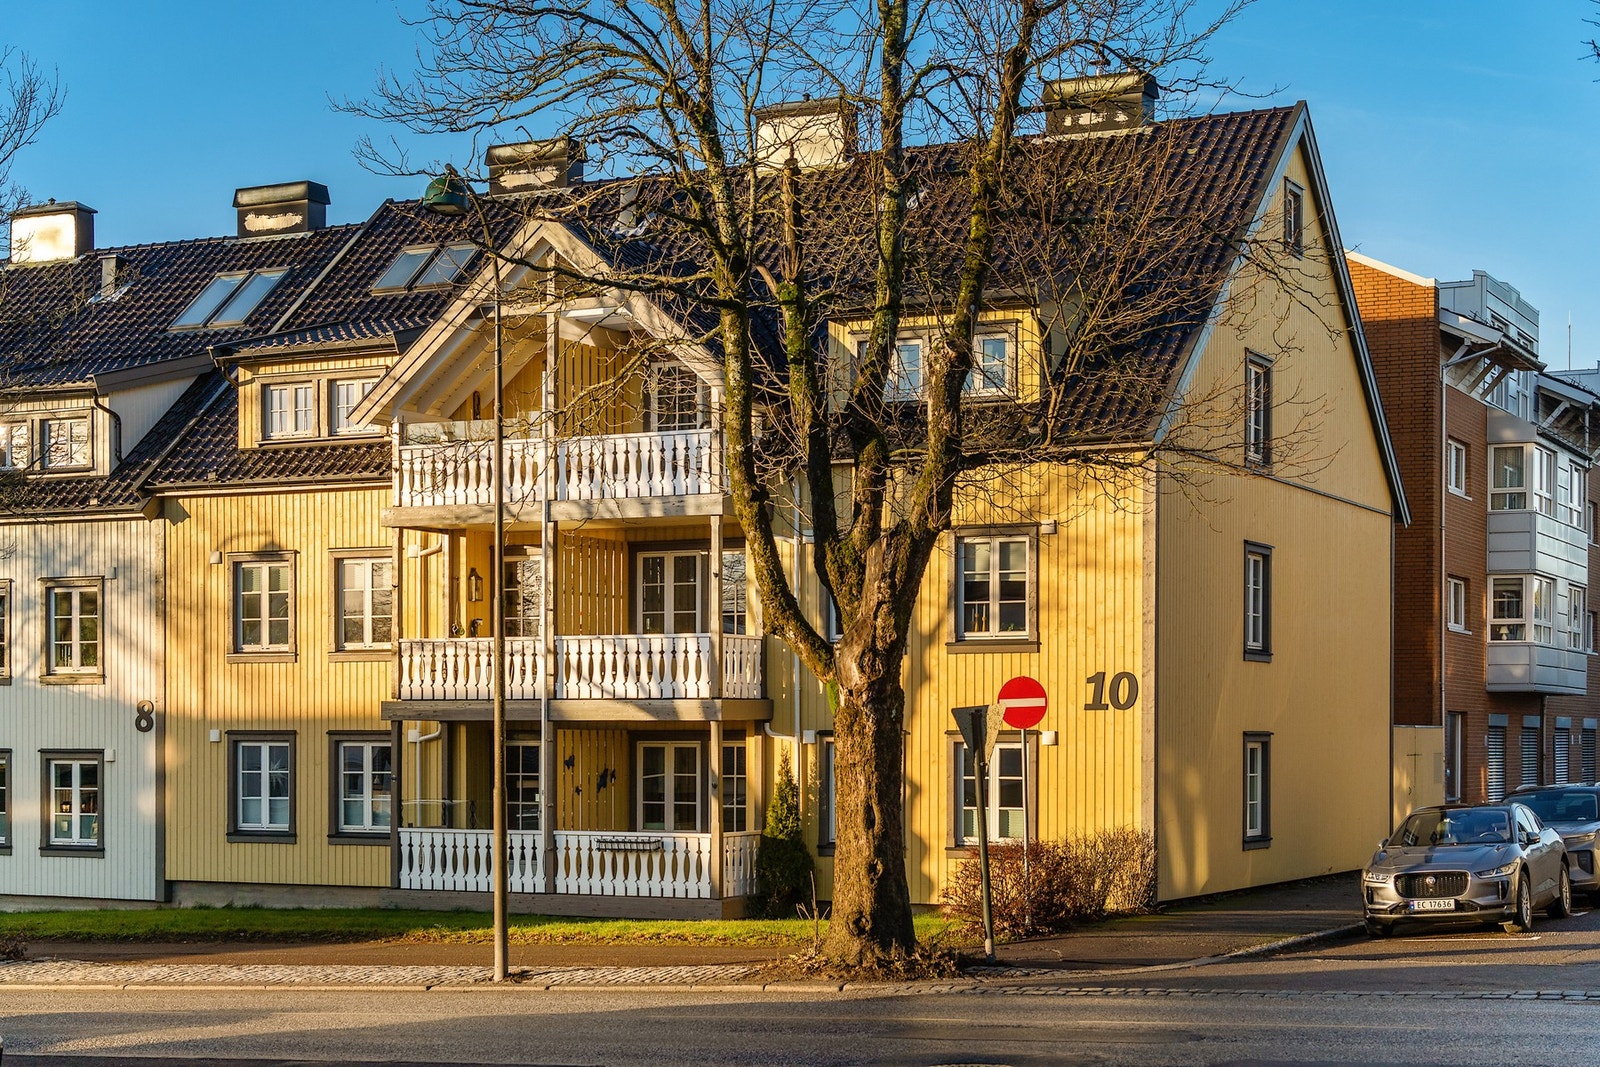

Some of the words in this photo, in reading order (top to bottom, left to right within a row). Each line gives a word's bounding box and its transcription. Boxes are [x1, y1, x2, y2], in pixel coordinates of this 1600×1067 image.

[1084, 671, 1139, 711] 10
[135, 700, 154, 732] 8
[1429, 900, 1452, 908] 17636
